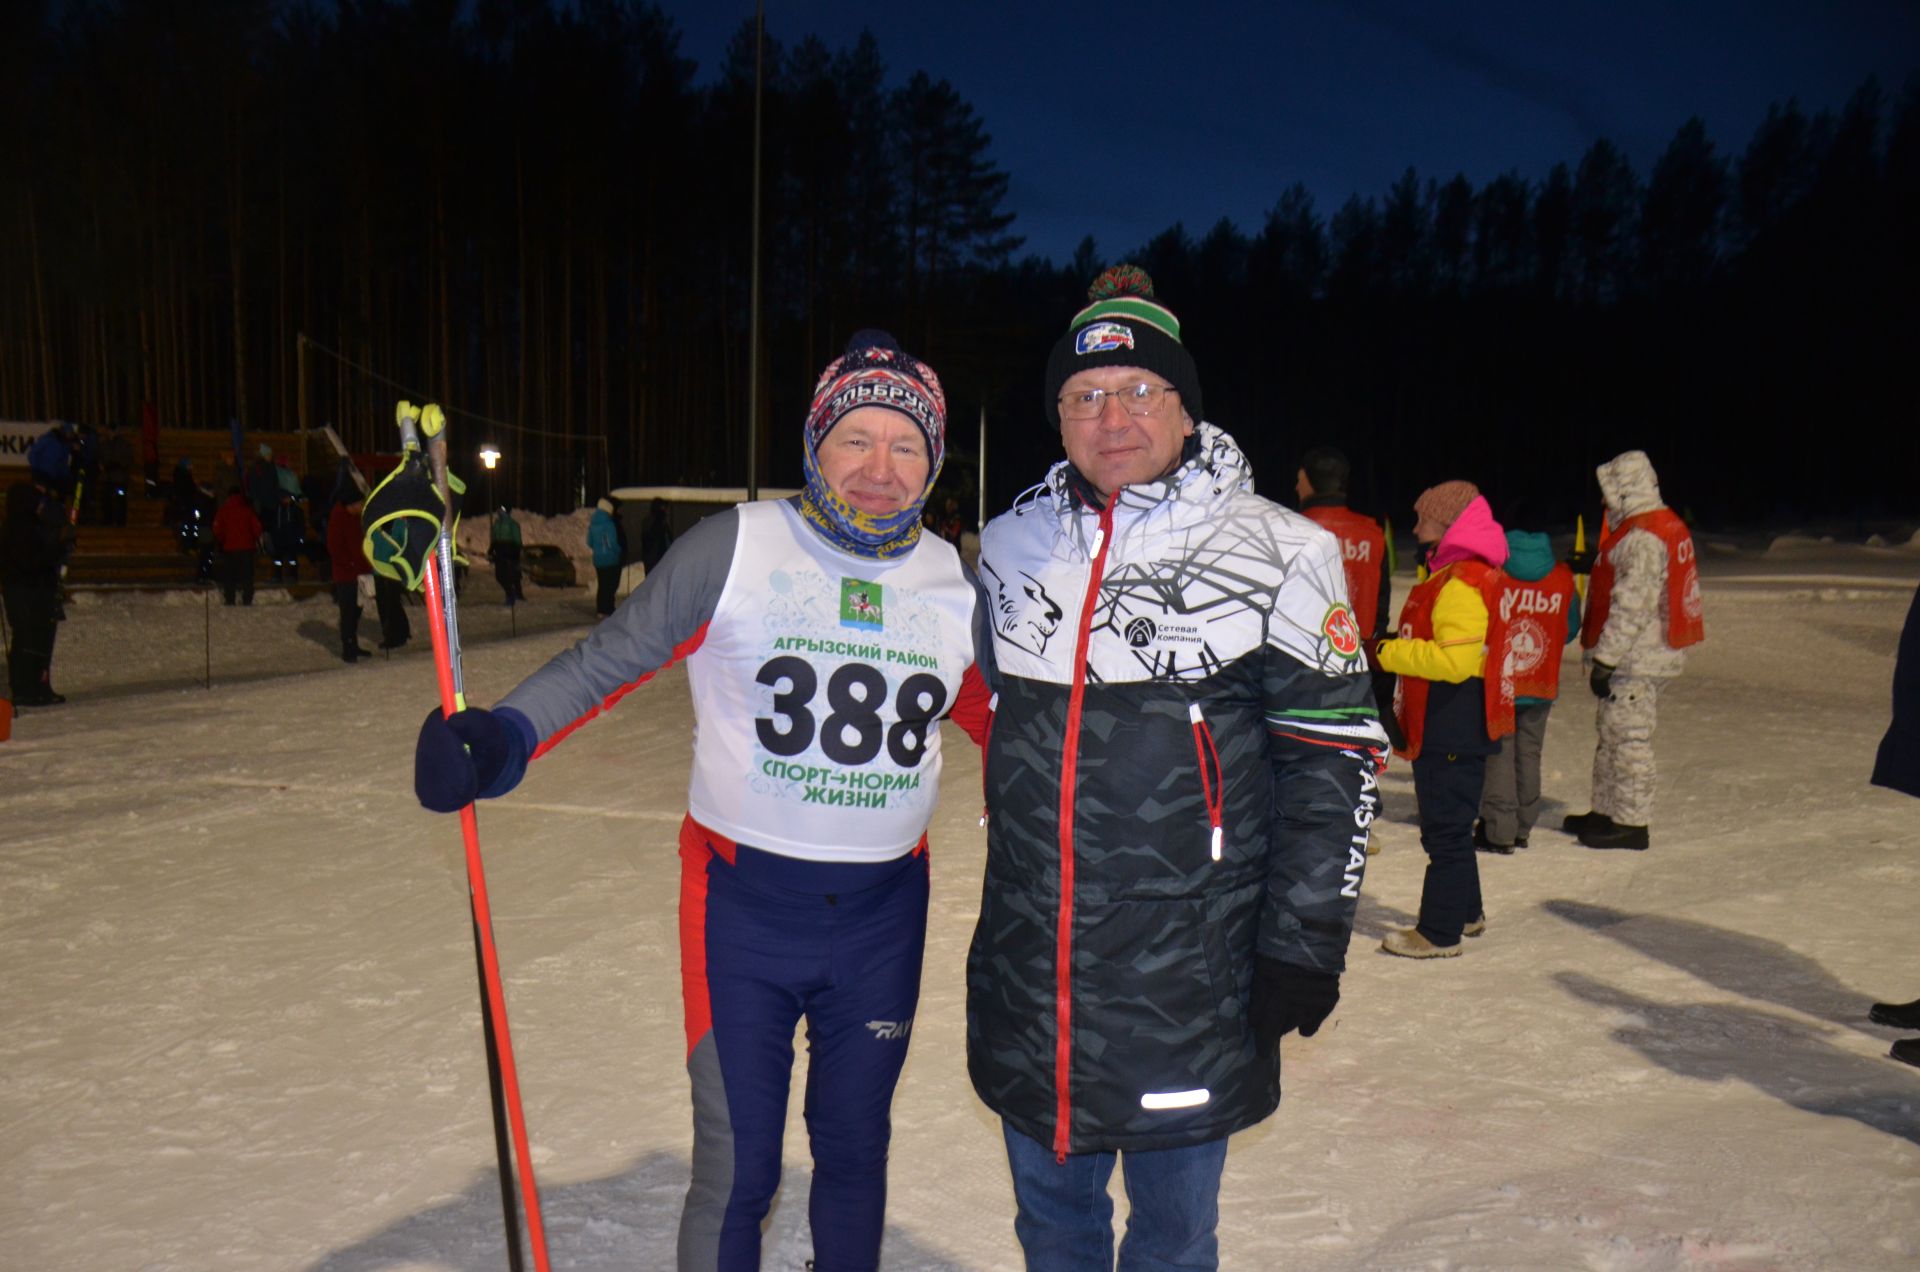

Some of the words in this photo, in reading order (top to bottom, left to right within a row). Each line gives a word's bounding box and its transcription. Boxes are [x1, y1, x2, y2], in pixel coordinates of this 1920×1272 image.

[1503, 587, 1562, 615] УДЬЯ
[1157, 634, 1202, 644] Компания
[1158, 624, 1198, 634] Сетевая
[774, 637, 881, 660] АГРЫЗСКИЙ
[886, 649, 938, 669] РАЙОН
[755, 655, 947, 768] 388
[801, 786, 887, 809] ЖИЗНИ
